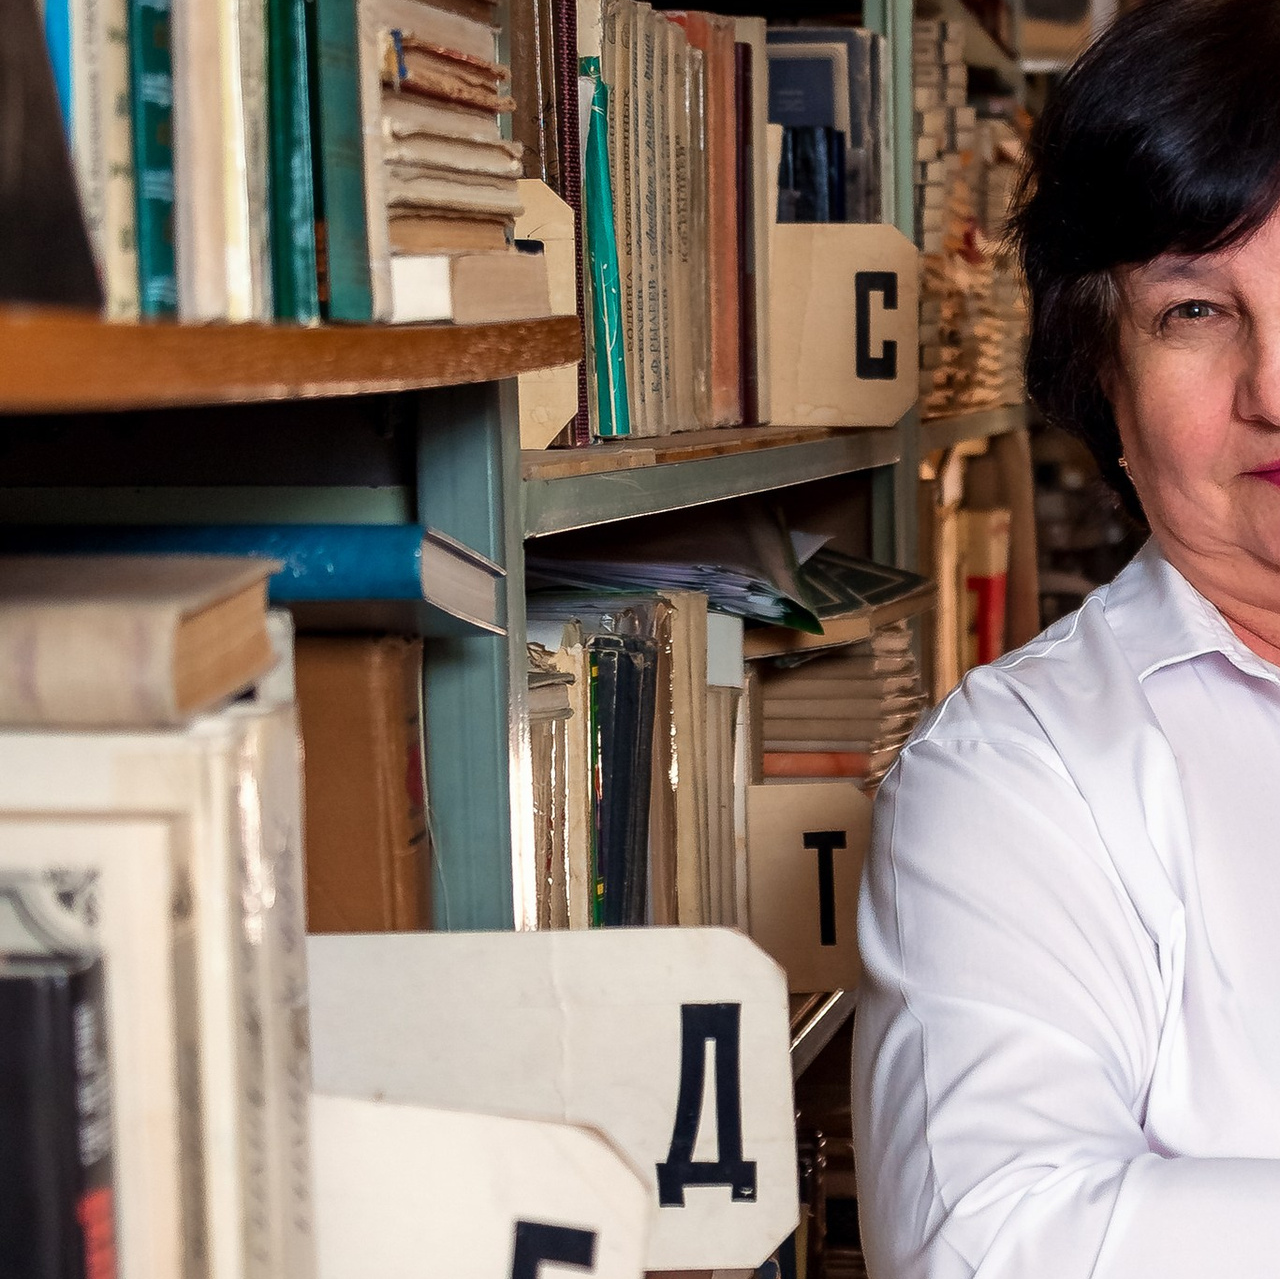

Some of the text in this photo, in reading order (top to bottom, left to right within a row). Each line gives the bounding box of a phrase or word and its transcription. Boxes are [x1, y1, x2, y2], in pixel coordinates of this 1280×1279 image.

[854, 270, 898, 380] С
[803, 831, 847, 947] Т
[655, 1002, 758, 1208] Д
